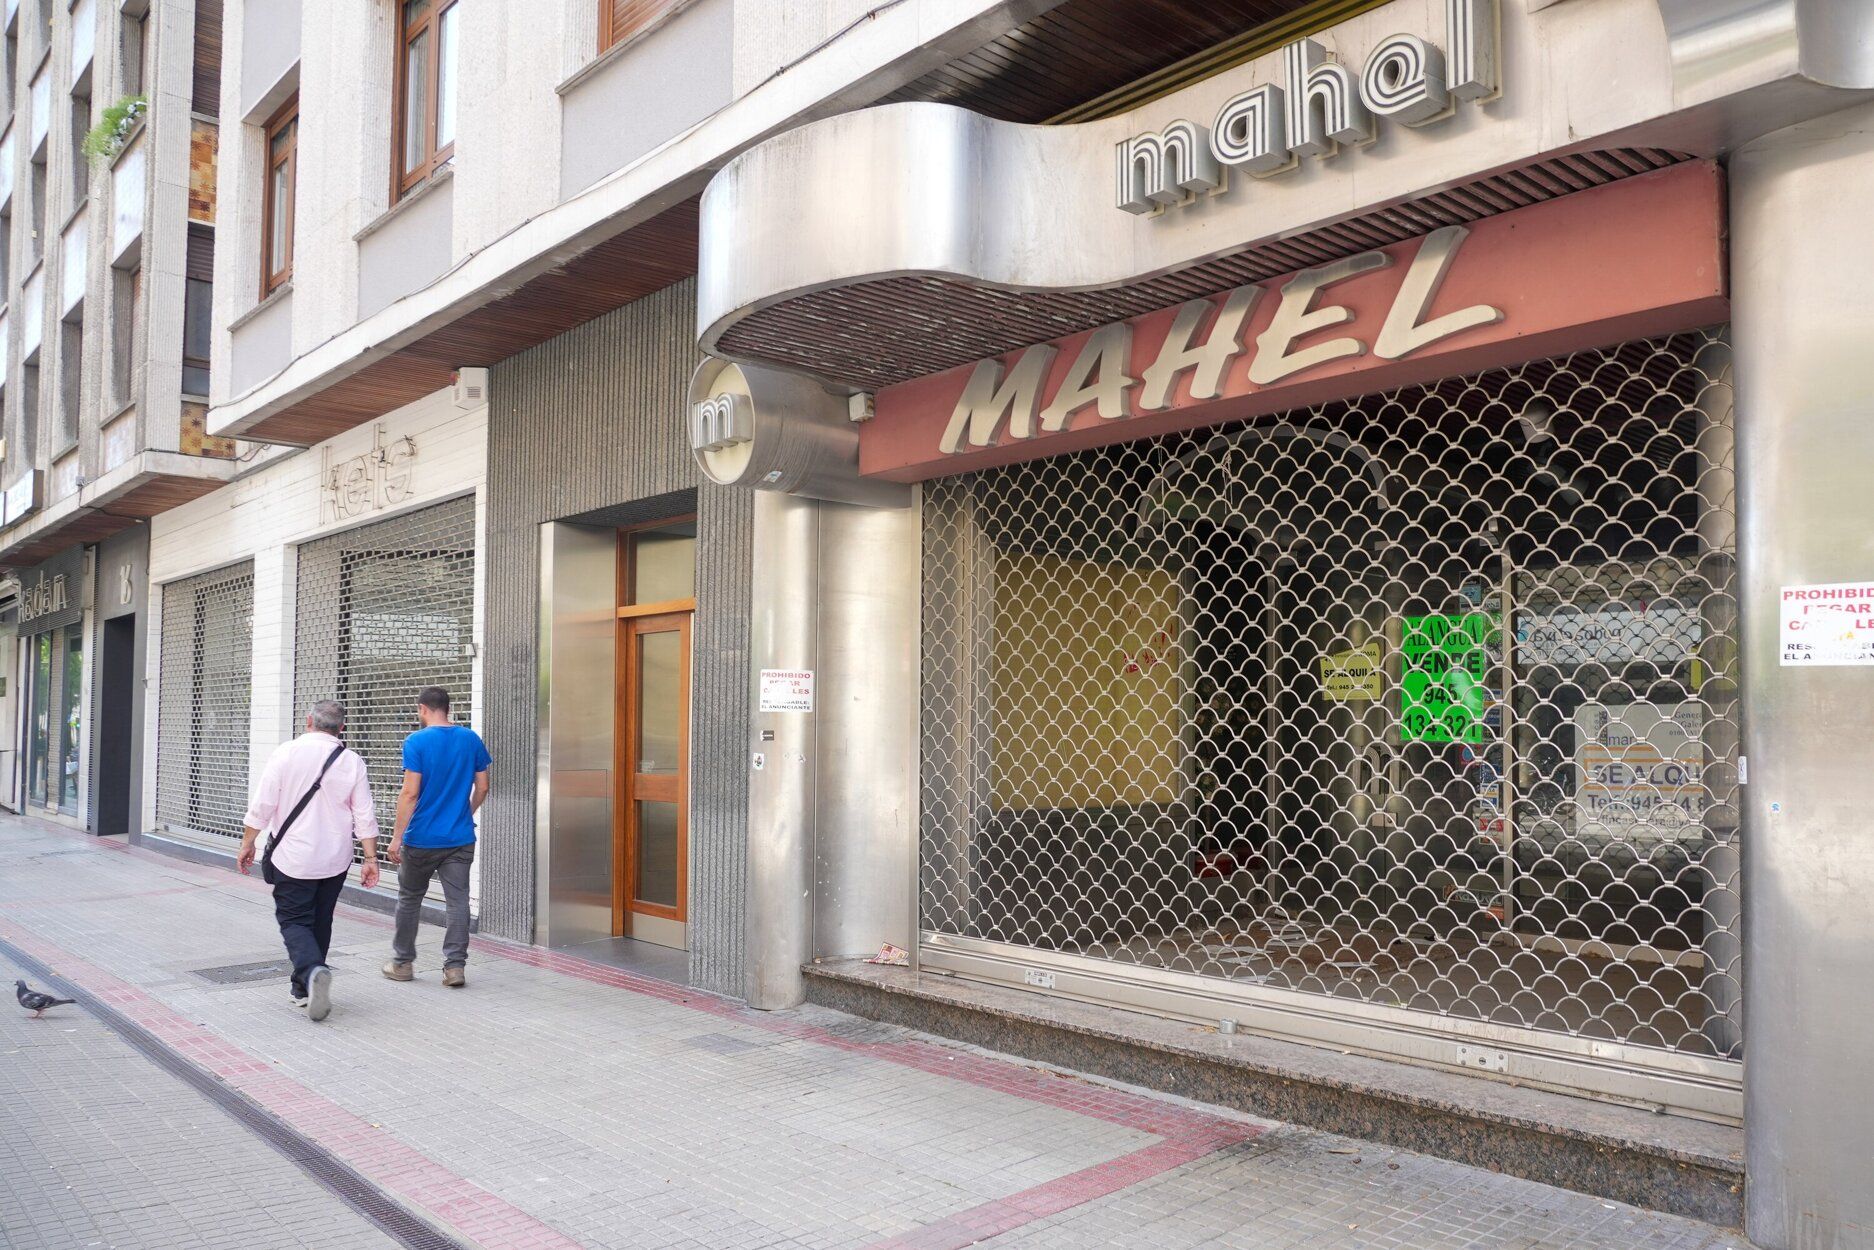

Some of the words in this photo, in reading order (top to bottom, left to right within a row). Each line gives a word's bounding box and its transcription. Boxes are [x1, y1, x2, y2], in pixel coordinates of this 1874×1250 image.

[938, 225, 1504, 455] MAHEL
[1405, 652, 1480, 674] VENDE
[761, 671, 811, 679] PROHIBIDO
[1423, 683, 1458, 704] 945
[1593, 765, 1623, 784] SE
